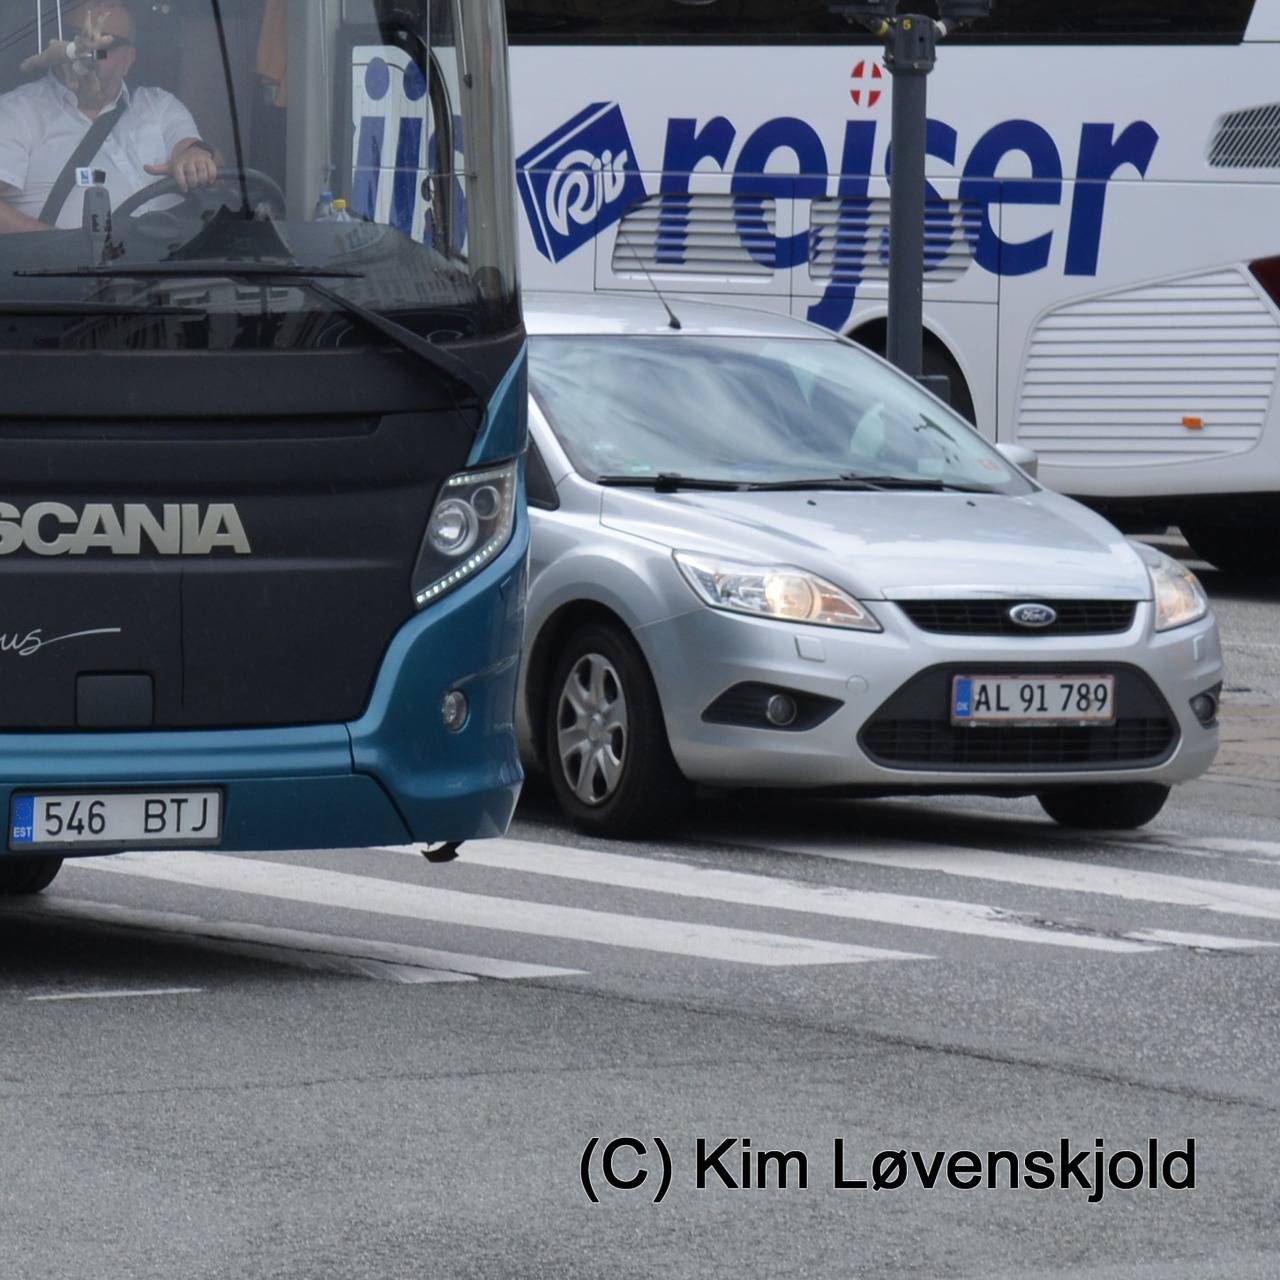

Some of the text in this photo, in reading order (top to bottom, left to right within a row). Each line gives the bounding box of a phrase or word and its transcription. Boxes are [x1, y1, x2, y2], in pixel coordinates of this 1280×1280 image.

[654, 60, 1159, 331] rejser
[1021, 605, 1048, 621] Ford
[974, 683, 1011, 712] AL
[1019, 683, 1049, 713] 91
[1059, 682, 1109, 712] 789
[13, 797, 209, 838] EST 546 BTJ
